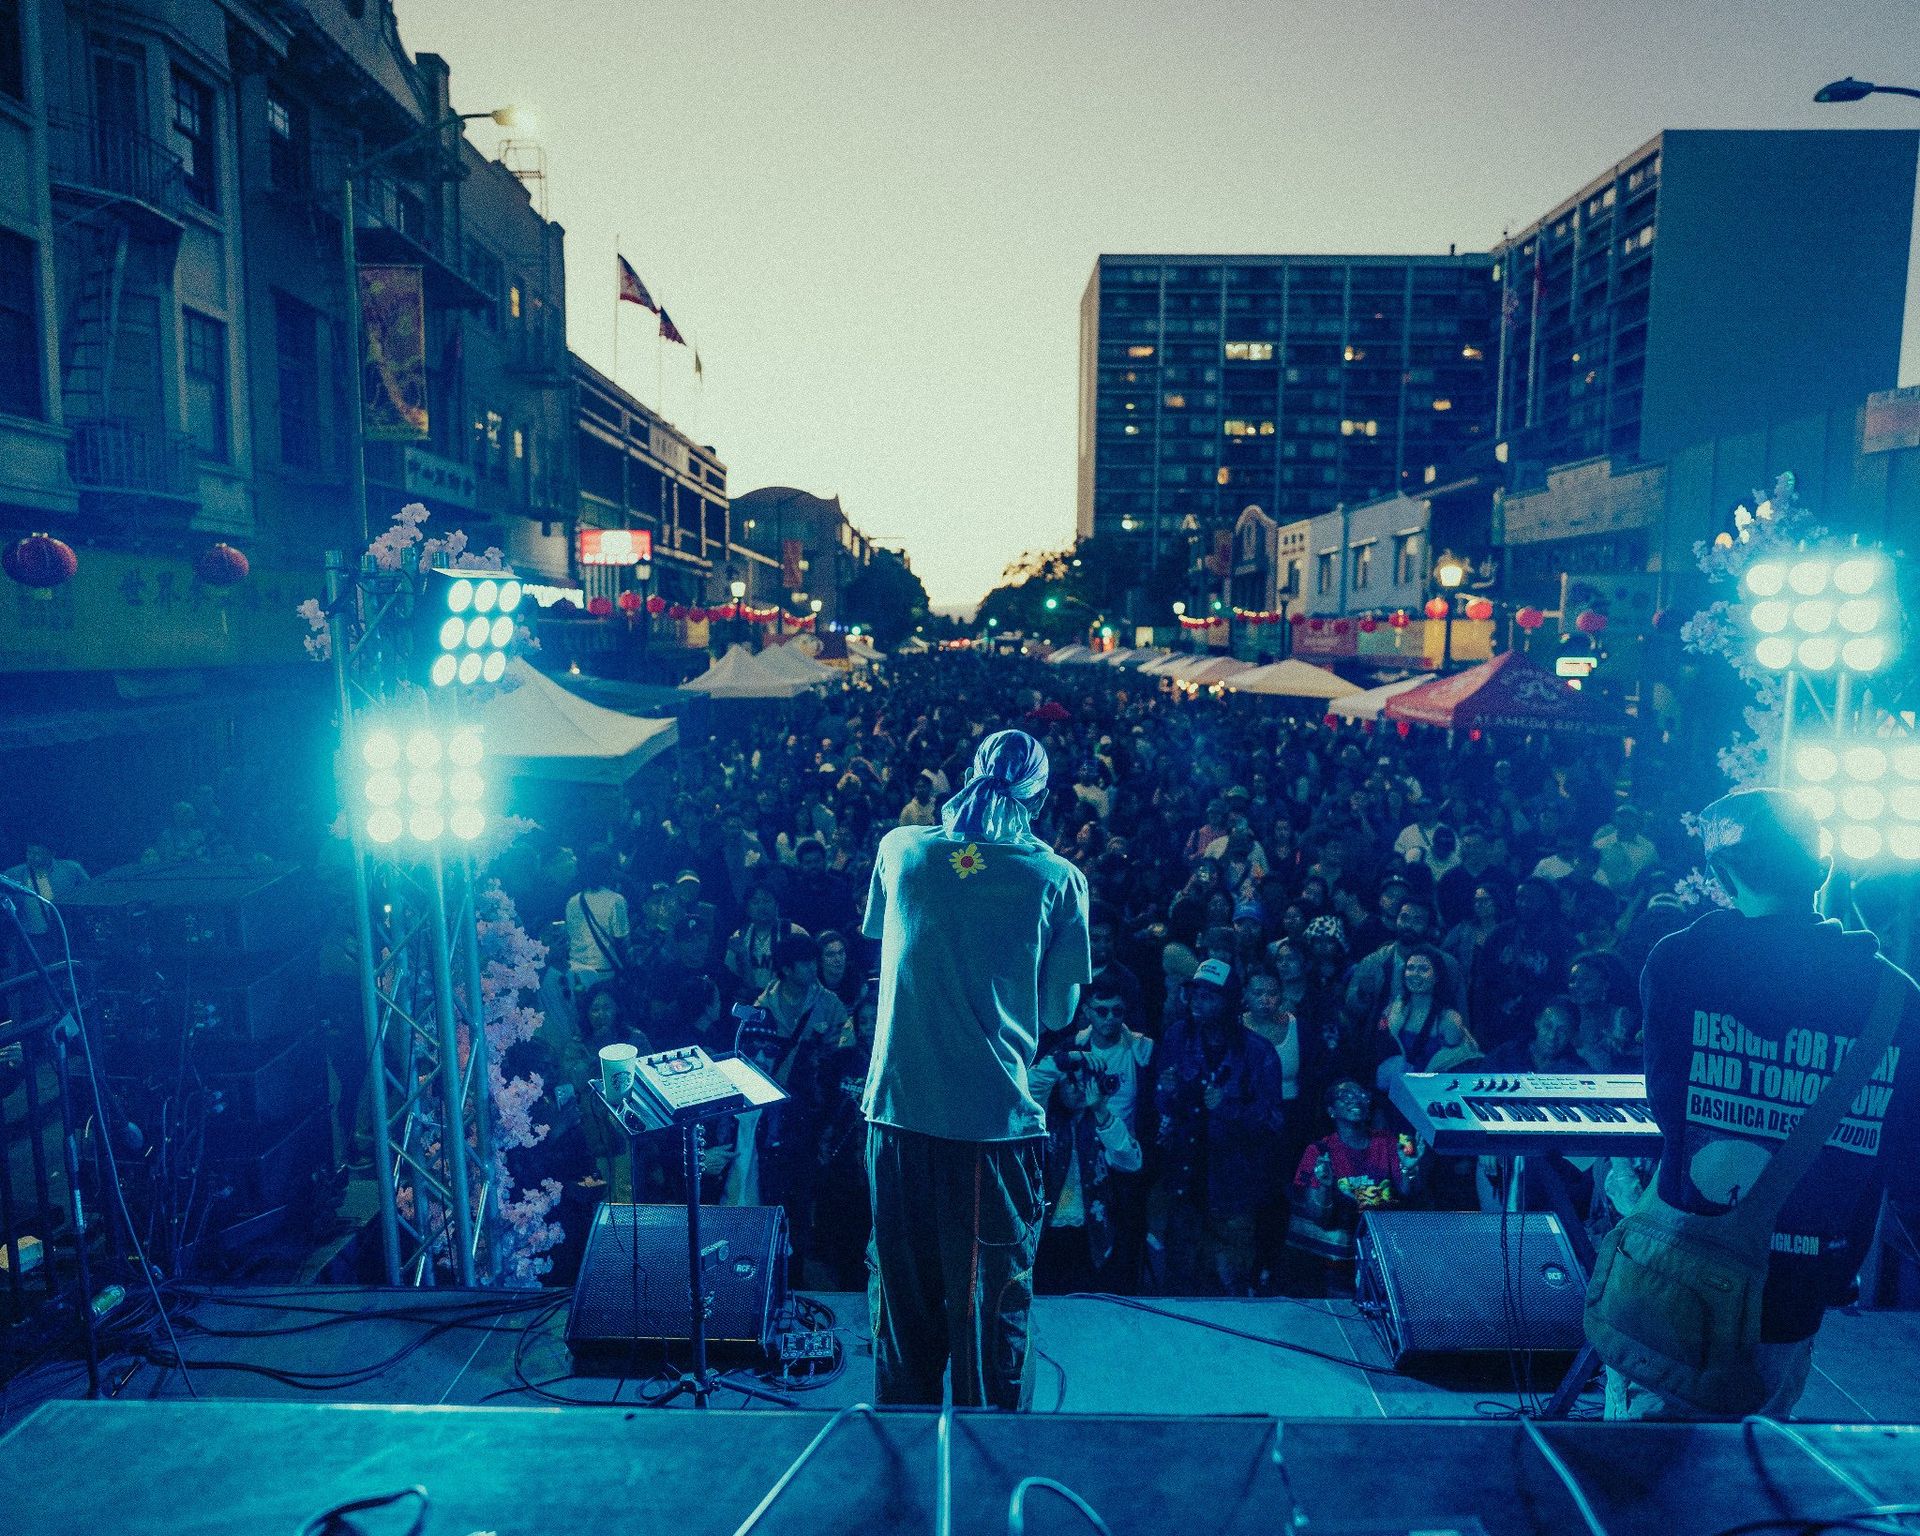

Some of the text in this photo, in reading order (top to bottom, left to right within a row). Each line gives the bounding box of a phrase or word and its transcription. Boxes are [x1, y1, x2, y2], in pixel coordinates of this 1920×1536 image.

[1784, 1028, 1828, 1070] FOR
[1833, 1036, 1900, 1083] TAY
[1689, 1051, 1894, 1118] AND TOMOOW
[1690, 1094, 1878, 1149] BASILICA DES TUDIO
